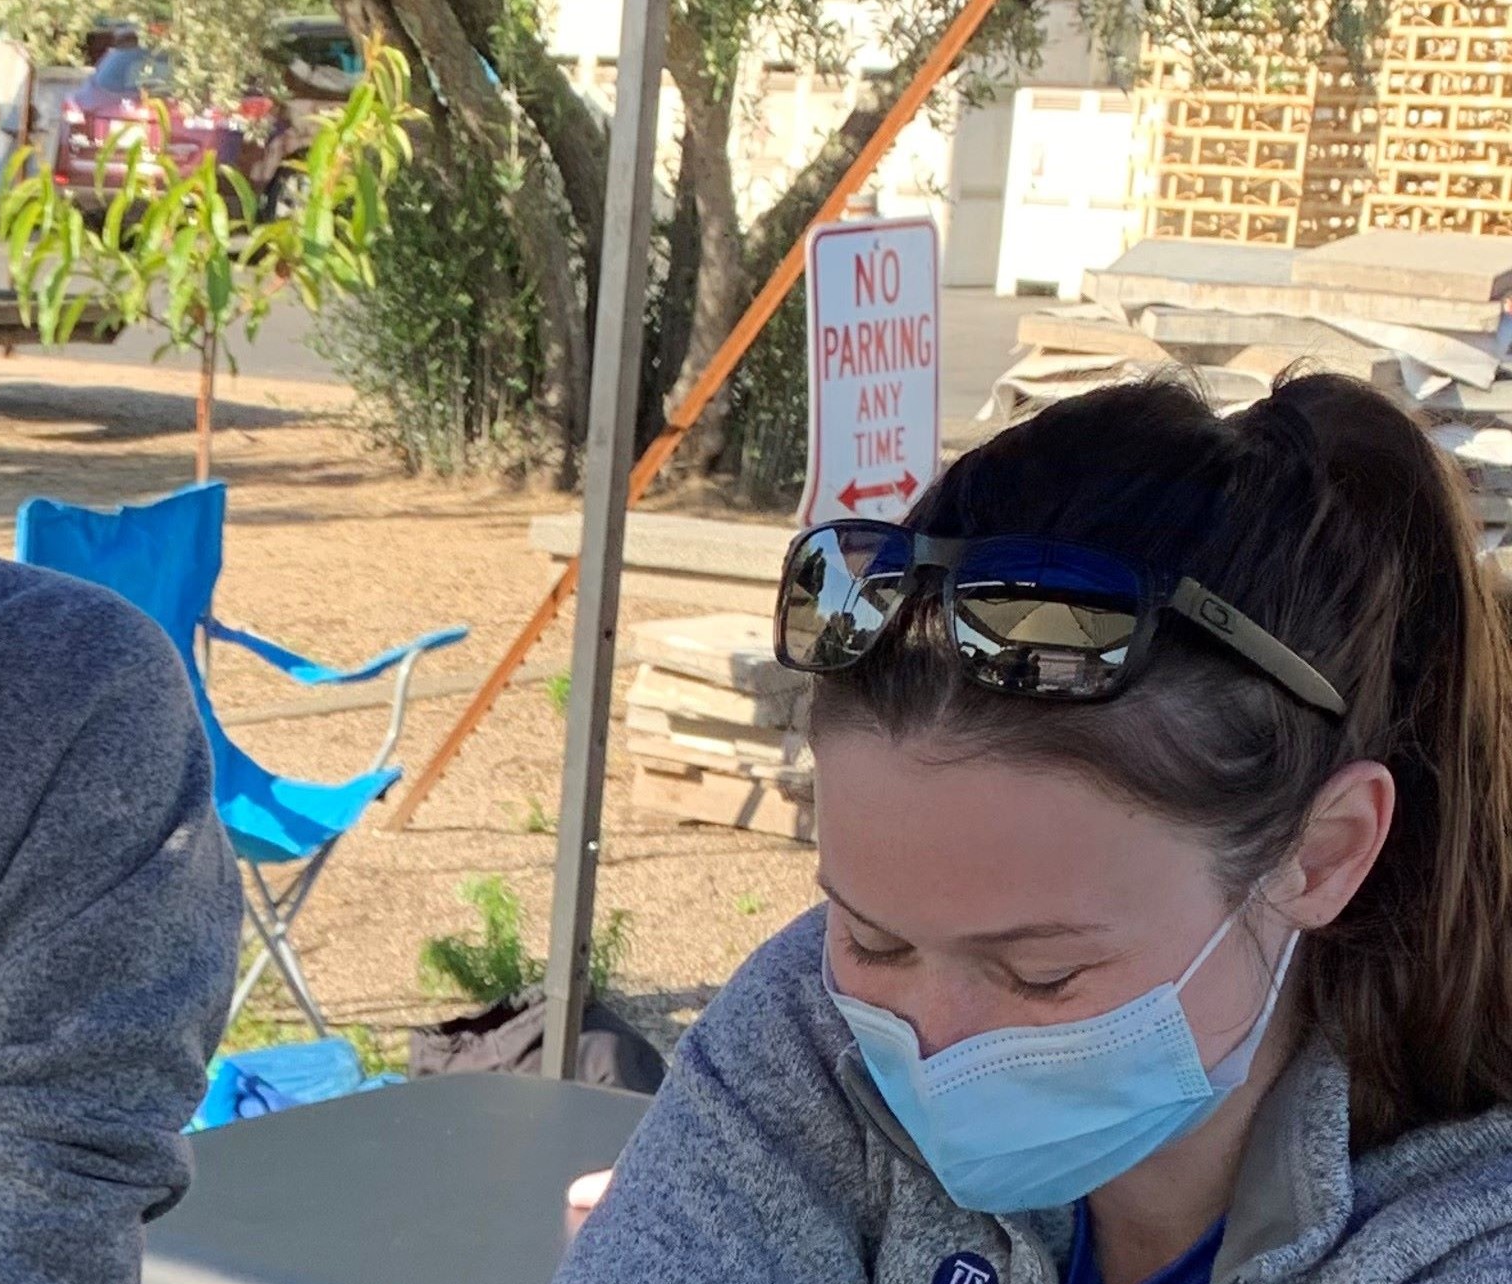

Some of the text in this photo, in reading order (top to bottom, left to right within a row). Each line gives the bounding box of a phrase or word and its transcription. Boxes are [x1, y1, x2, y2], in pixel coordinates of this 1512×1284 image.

[854, 249, 900, 307] NO
[822, 314, 931, 381] PARKING
[856, 381, 903, 423] ANY
[853, 427, 906, 468] TIME
